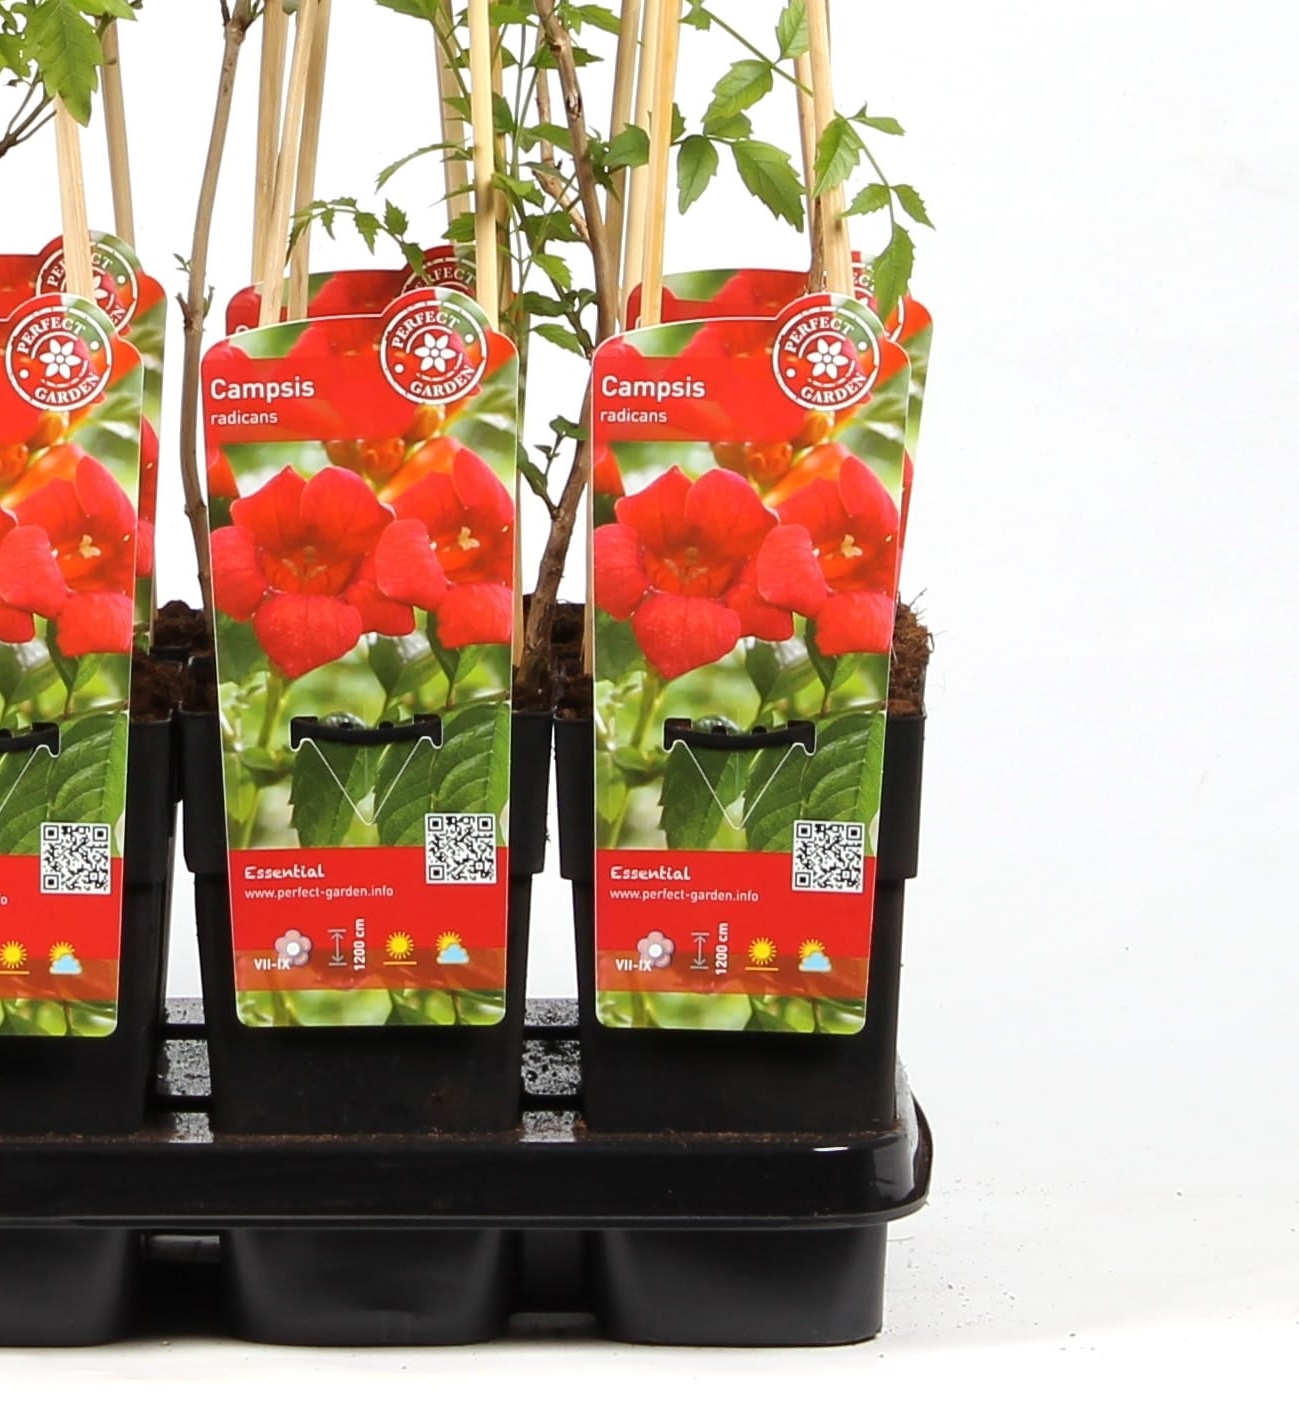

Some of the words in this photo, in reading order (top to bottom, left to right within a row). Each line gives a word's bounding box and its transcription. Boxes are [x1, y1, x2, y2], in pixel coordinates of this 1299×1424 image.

[17, 317, 86, 354] PERFECT
[391, 310, 460, 348] PERFECT
[785, 316, 855, 353] PERFECT
[35, 371, 100, 404] GARDEN
[210, 376, 315, 403] Campsis
[410, 365, 476, 397] GARDEN
[601, 375, 706, 402] Campsis
[801, 373, 867, 404] GARDEN
[210, 410, 278, 425] radicans
[600, 408, 667, 423] radicans
[244, 864, 325, 880] Essential
[610, 865, 691, 881] Essential
[245, 884, 394, 901] www.perfect-garden.info
[610, 888, 759, 903] www.perfect-garden.info
[354, 918, 365, 938] cm
[717, 922, 729, 942] cm
[253, 958, 291, 971] VII-IX
[354, 940, 366, 971] 1200
[615, 959, 652, 971] VII-IX
[715, 944, 727, 975] 1200
